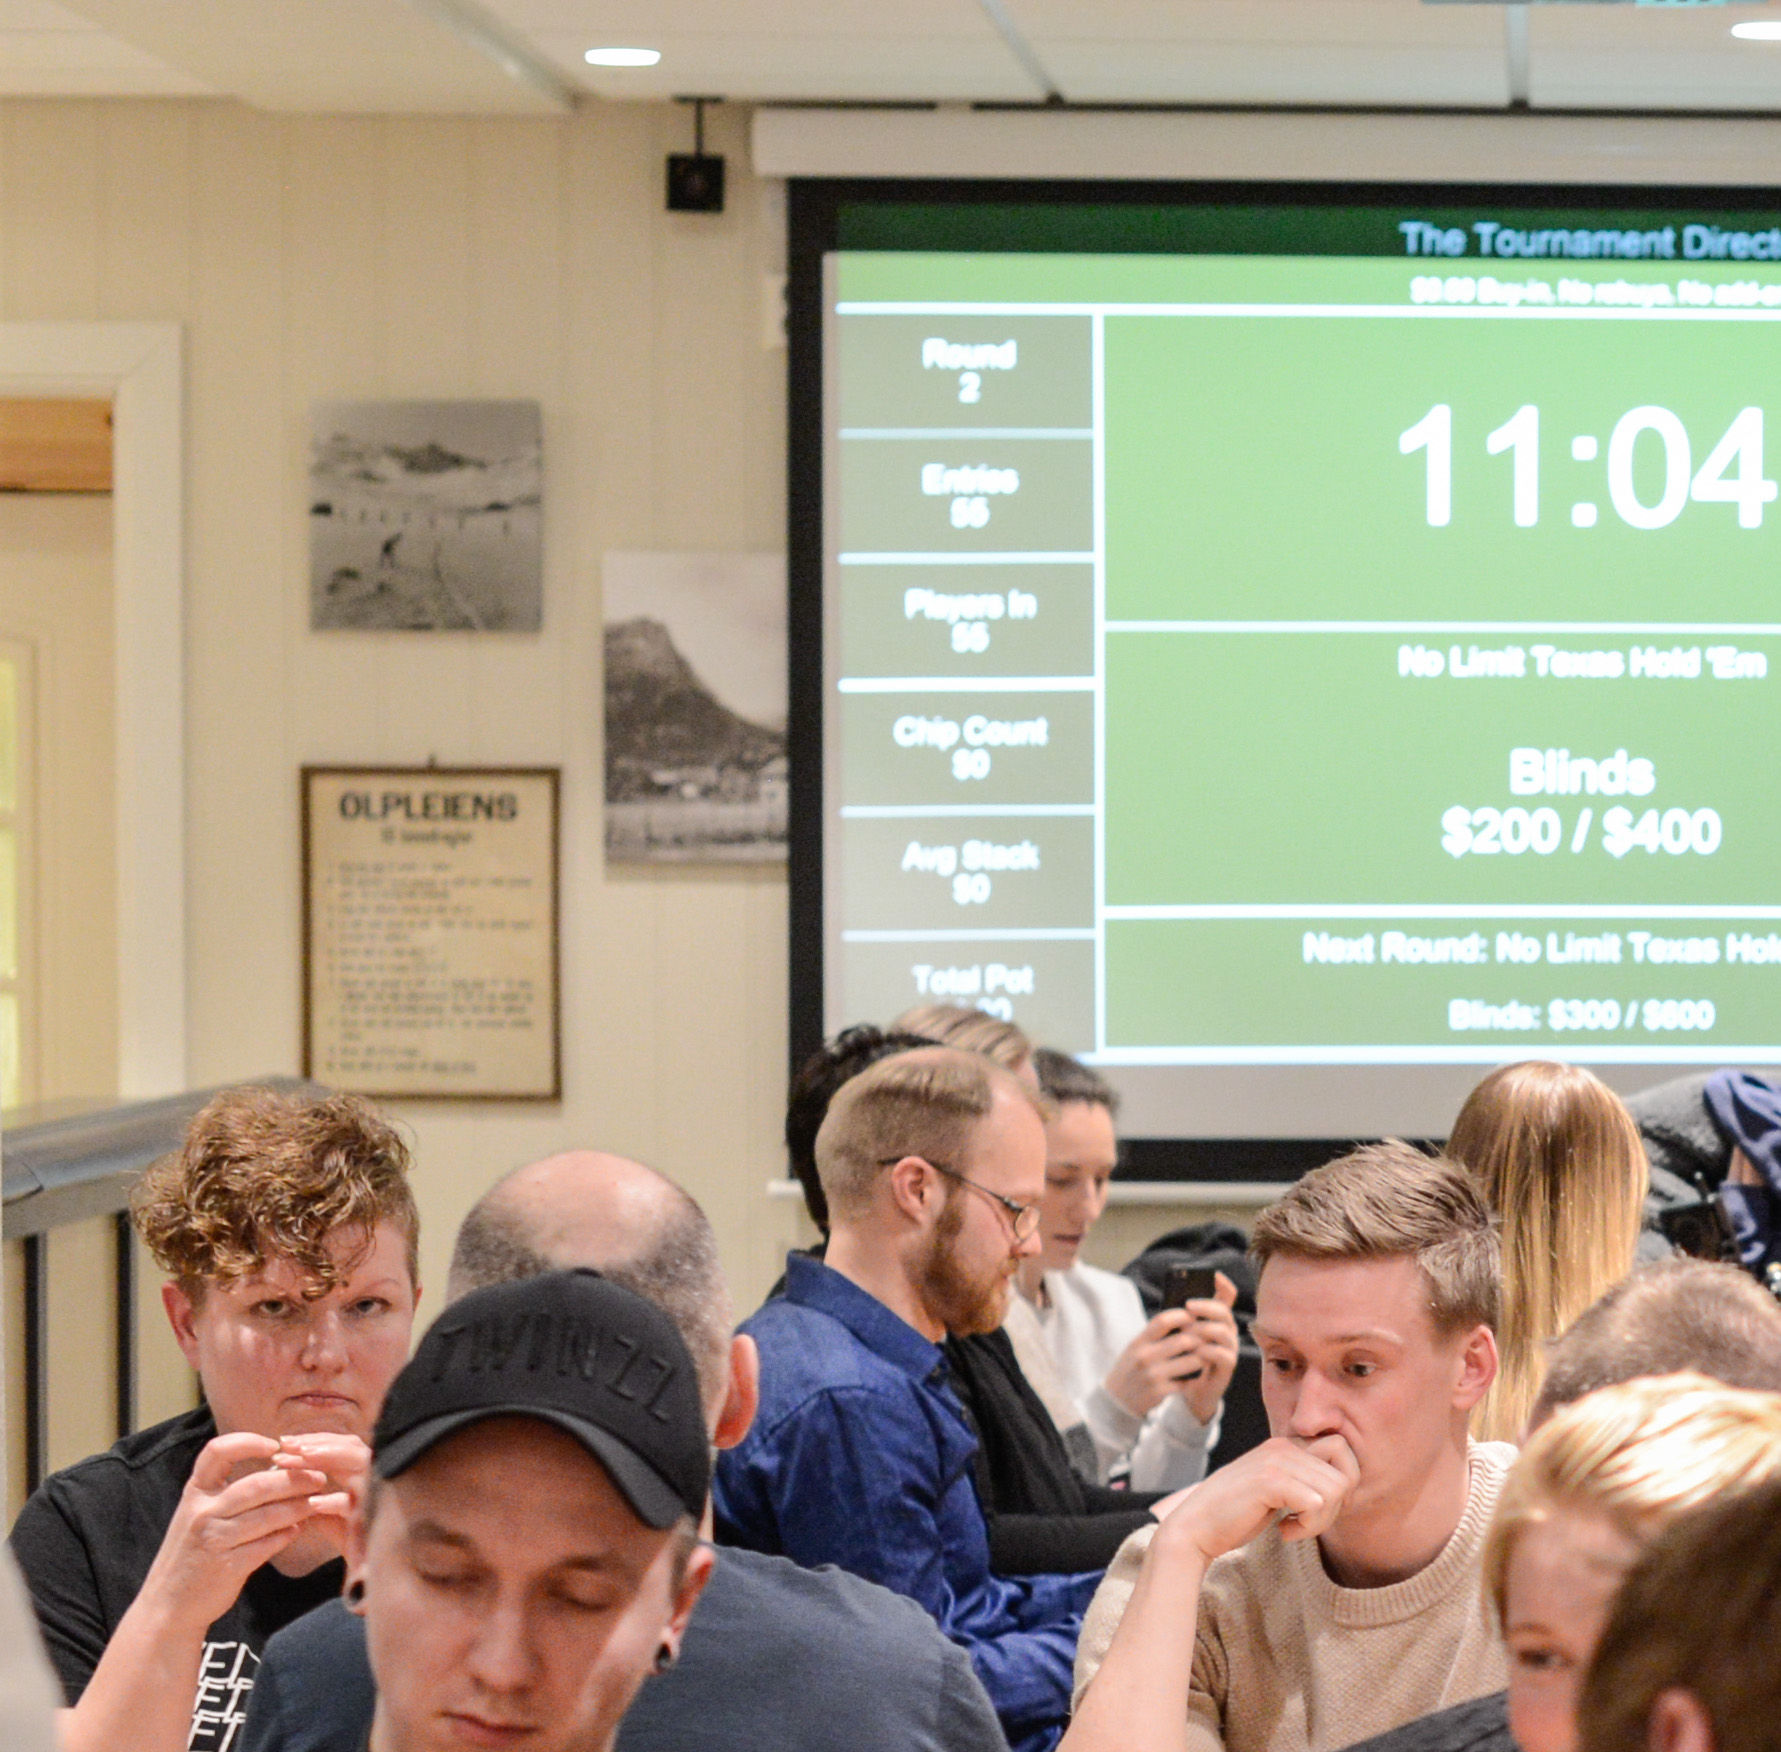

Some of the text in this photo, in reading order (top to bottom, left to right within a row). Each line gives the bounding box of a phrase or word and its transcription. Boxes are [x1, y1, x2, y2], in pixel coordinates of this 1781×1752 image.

[1399, 221, 1467, 256] The
[1473, 222, 1675, 258] Tournament
[922, 338, 1017, 370] Round
[959, 372, 981, 403] 2
[922, 463, 1019, 495] Entries
[1399, 404, 1778, 530] 11:04
[905, 588, 1005, 625] Players
[1398, 645, 1445, 677] No
[1449, 645, 1526, 678] Limit
[1530, 644, 1625, 678] Texas
[1630, 646, 1701, 678] Hold
[893, 715, 1048, 751] Chip Count
[1509, 747, 1656, 796] Blinds
[1441, 805, 1722, 858] $200 / $400
[901, 840, 1039, 876] Avg Stack
[1303, 931, 1375, 963] Next
[1381, 931, 1488, 963] Round:
[1496, 932, 1542, 963] No
[1546, 932, 1622, 963] Limit
[1627, 932, 1721, 964] Texas
[912, 964, 1033, 995] Total Pot
[1449, 999, 1541, 1030] Blinds:
[1548, 999, 1621, 1031] $300
[1624, 1001, 1639, 1028] /
